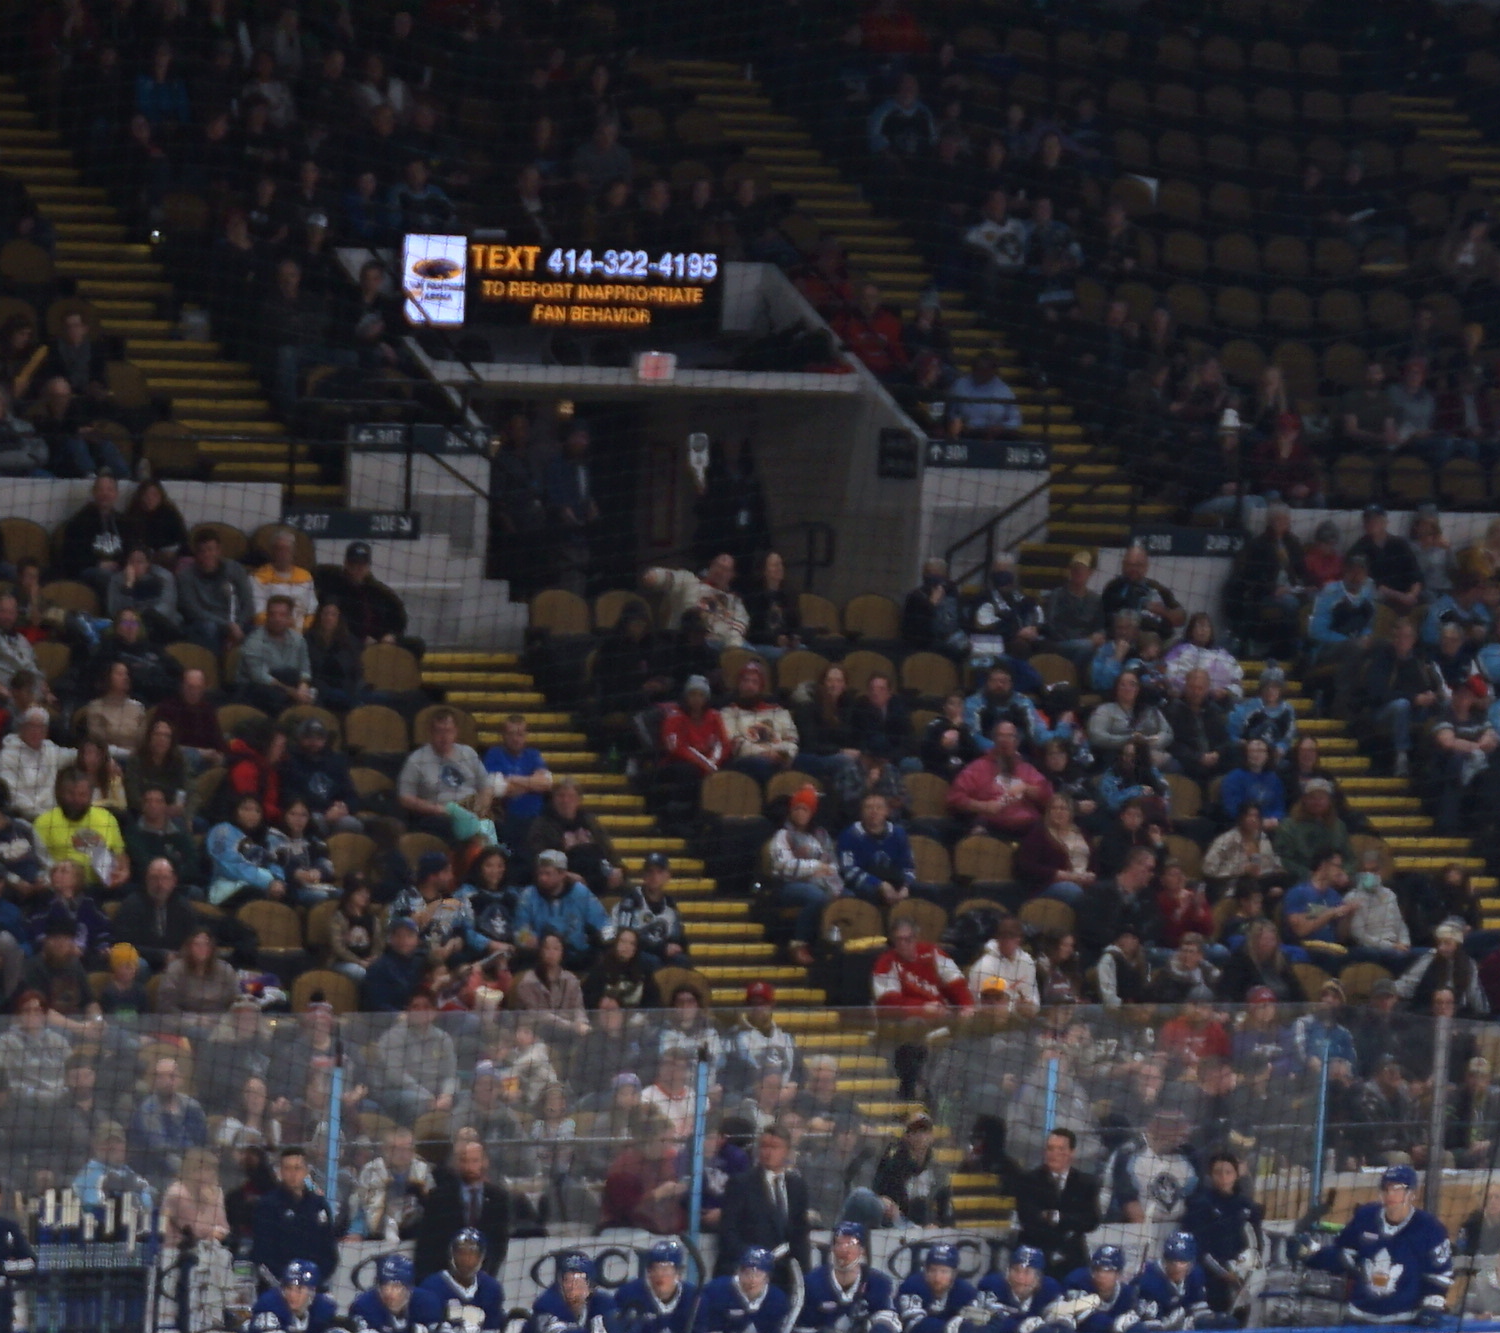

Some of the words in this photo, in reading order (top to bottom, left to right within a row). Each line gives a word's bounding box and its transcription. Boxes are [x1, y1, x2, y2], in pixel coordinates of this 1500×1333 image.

[471, 245, 540, 271] TEXT
[546, 247, 718, 279] 414-322-4195
[483, 281, 505, 297] TO
[509, 282, 574, 300] REPORT
[578, 284, 703, 304] INAPPROPRIATE
[533, 303, 565, 321] FAN
[570, 306, 651, 325] BEHAVIOR
